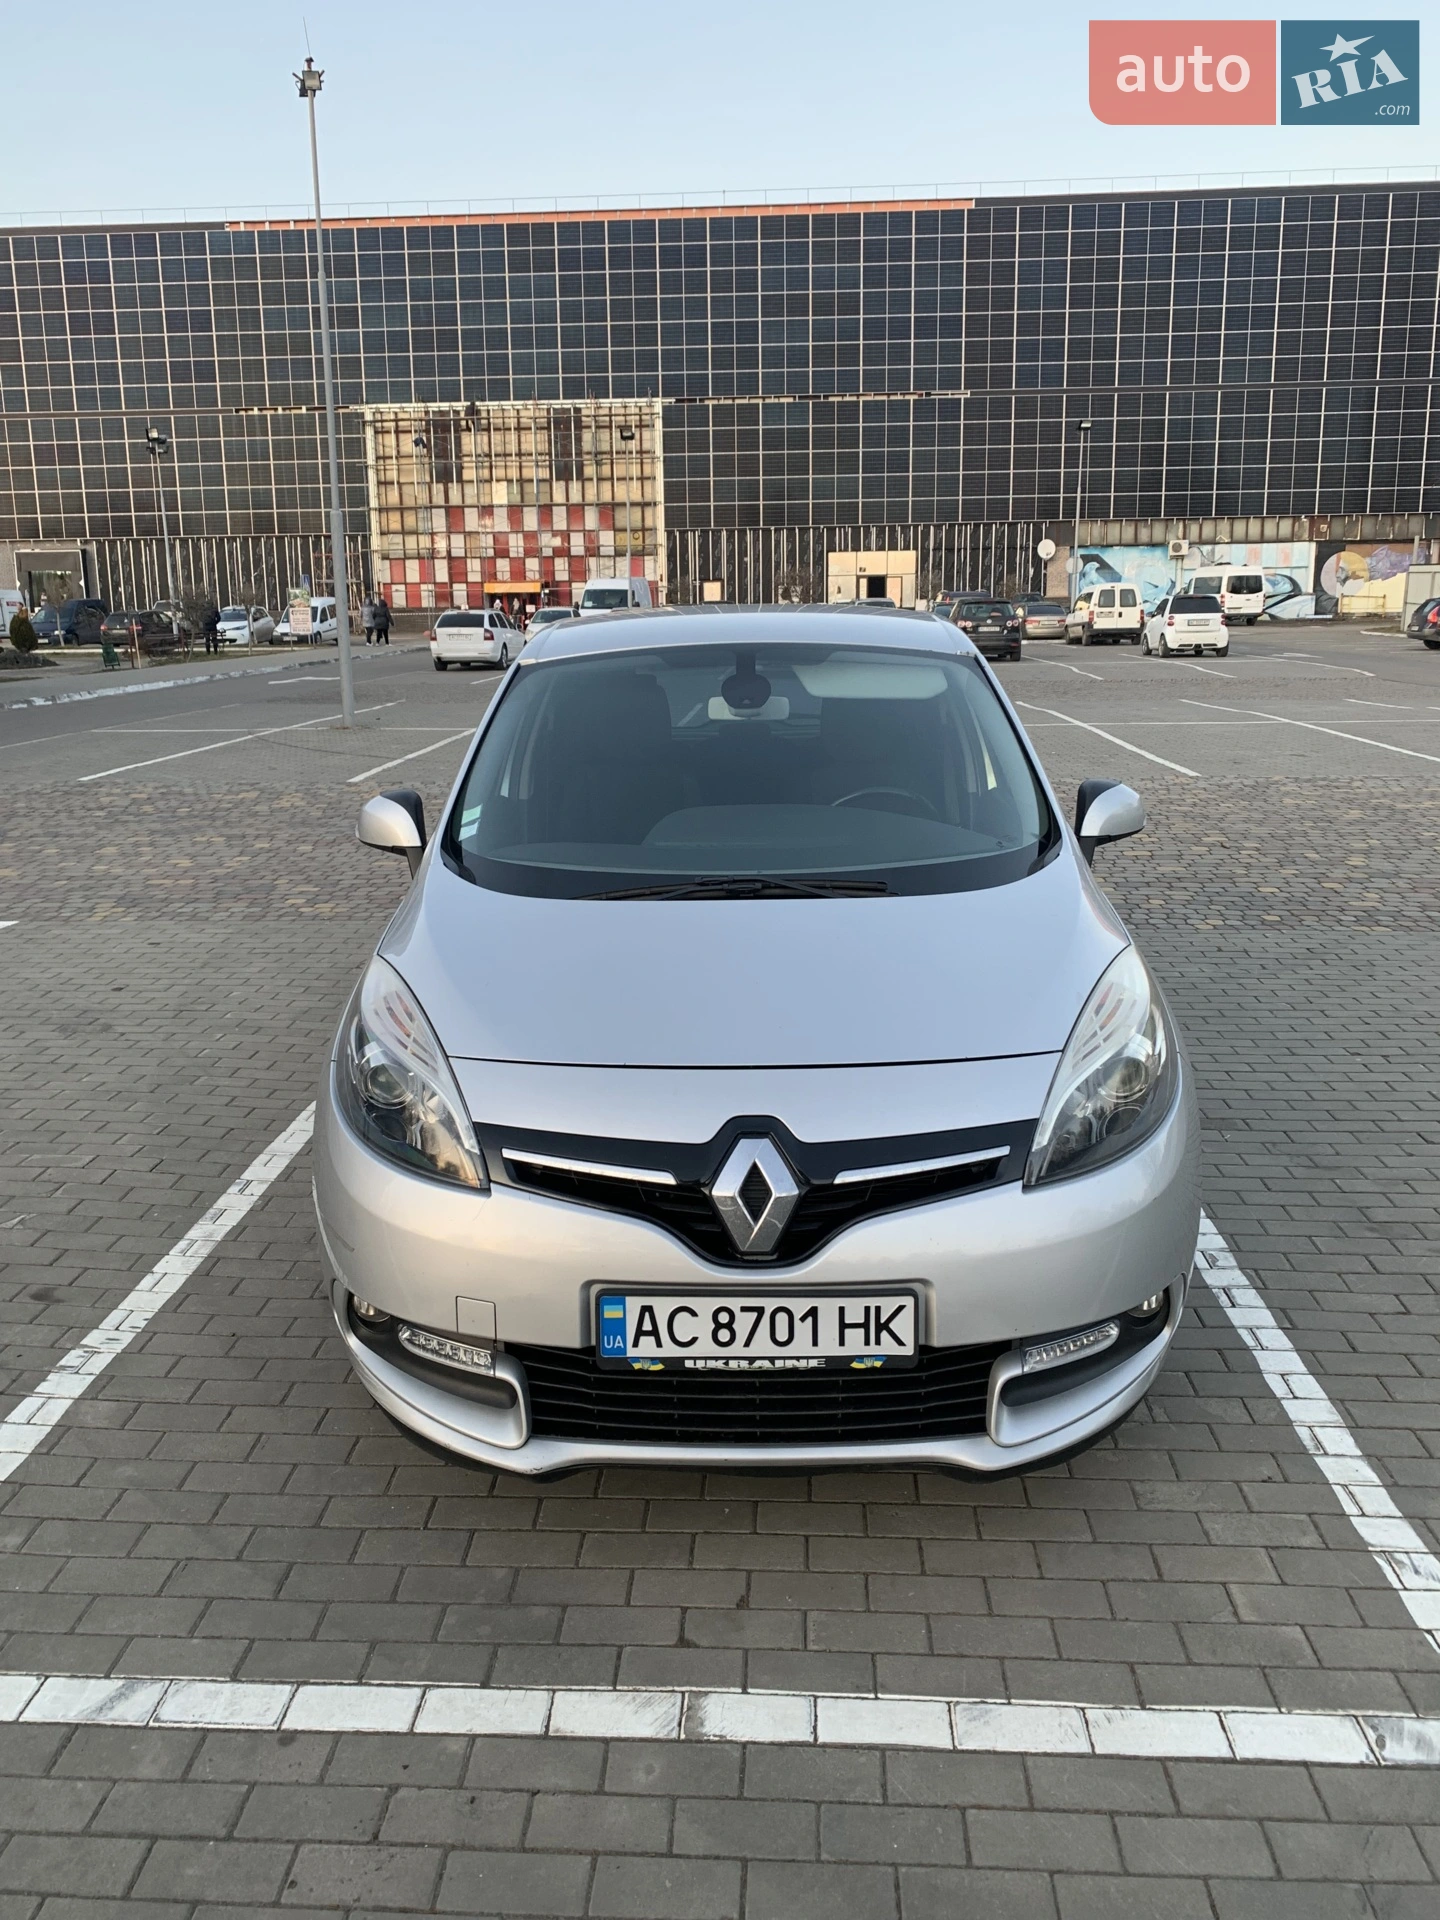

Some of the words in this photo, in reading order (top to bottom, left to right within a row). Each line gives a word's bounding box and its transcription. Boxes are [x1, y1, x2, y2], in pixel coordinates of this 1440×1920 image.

[631, 1304, 700, 1349] AC
[710, 1305, 820, 1348] 8701
[837, 1305, 908, 1348] HK
[604, 1335, 625, 1349] UA
[684, 1358, 826, 1370] UKRAINE
